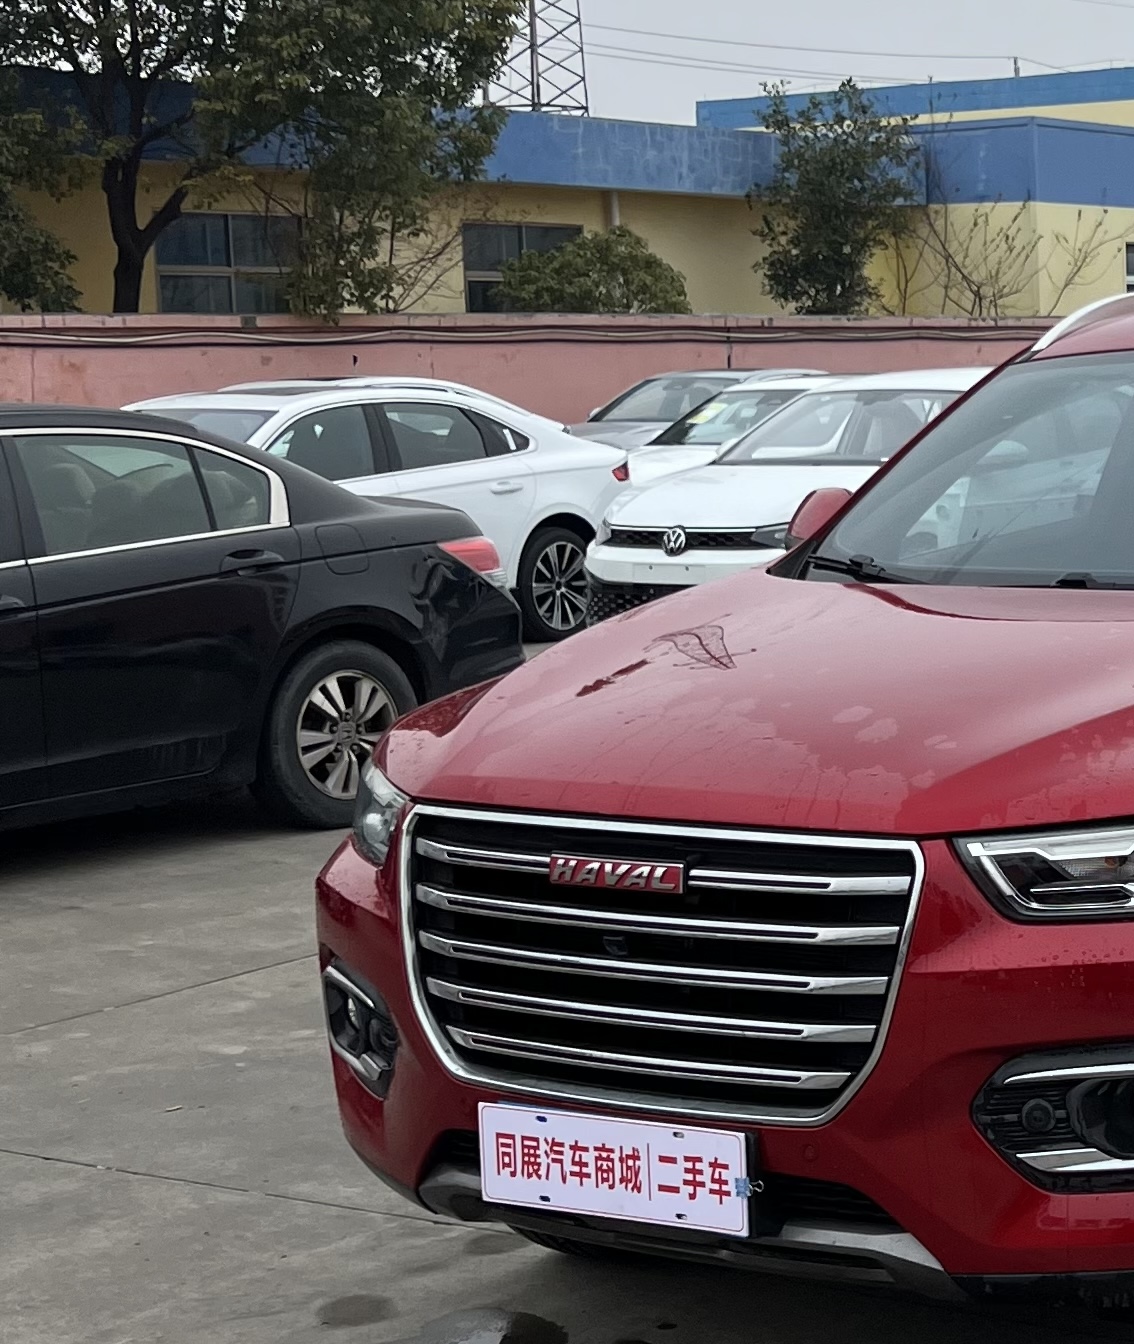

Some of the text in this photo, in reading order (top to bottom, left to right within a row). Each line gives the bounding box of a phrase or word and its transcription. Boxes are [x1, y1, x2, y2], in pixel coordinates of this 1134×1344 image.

[551, 858, 676, 890] HAVAL
[495, 1132, 731, 1205] 同展汽车商城 二手车
